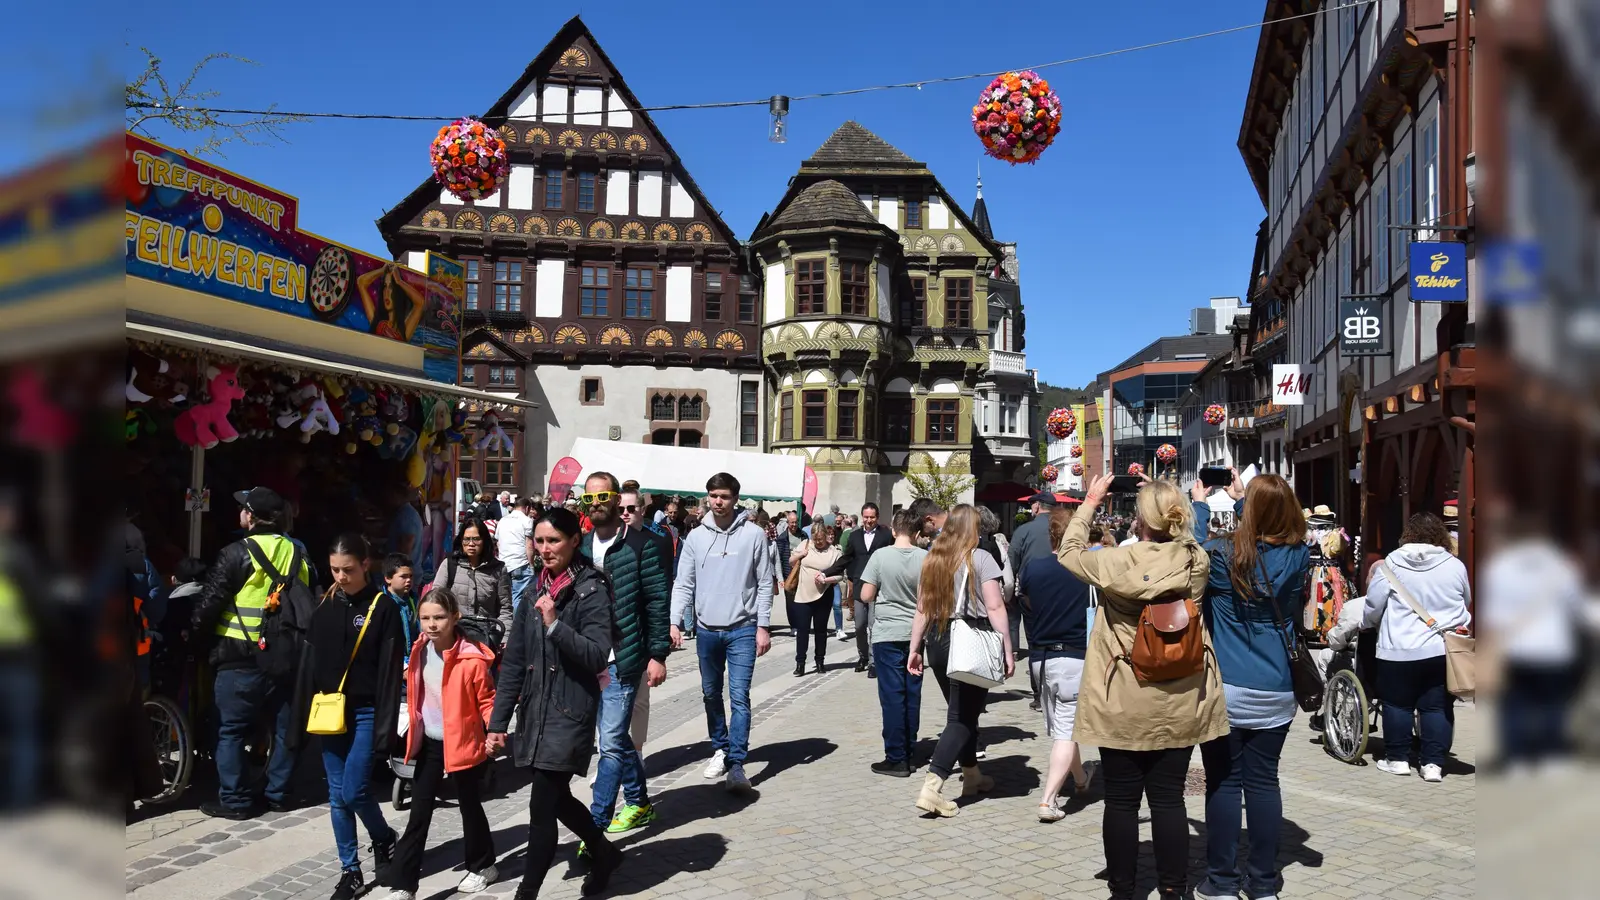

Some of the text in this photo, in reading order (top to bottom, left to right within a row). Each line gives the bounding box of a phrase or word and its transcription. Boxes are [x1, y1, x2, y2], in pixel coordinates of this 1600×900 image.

[133, 150, 285, 230] TREFFPUNKT
[1415, 275, 1461, 288] Tchibo
[1277, 373, 1313, 396] H&M
